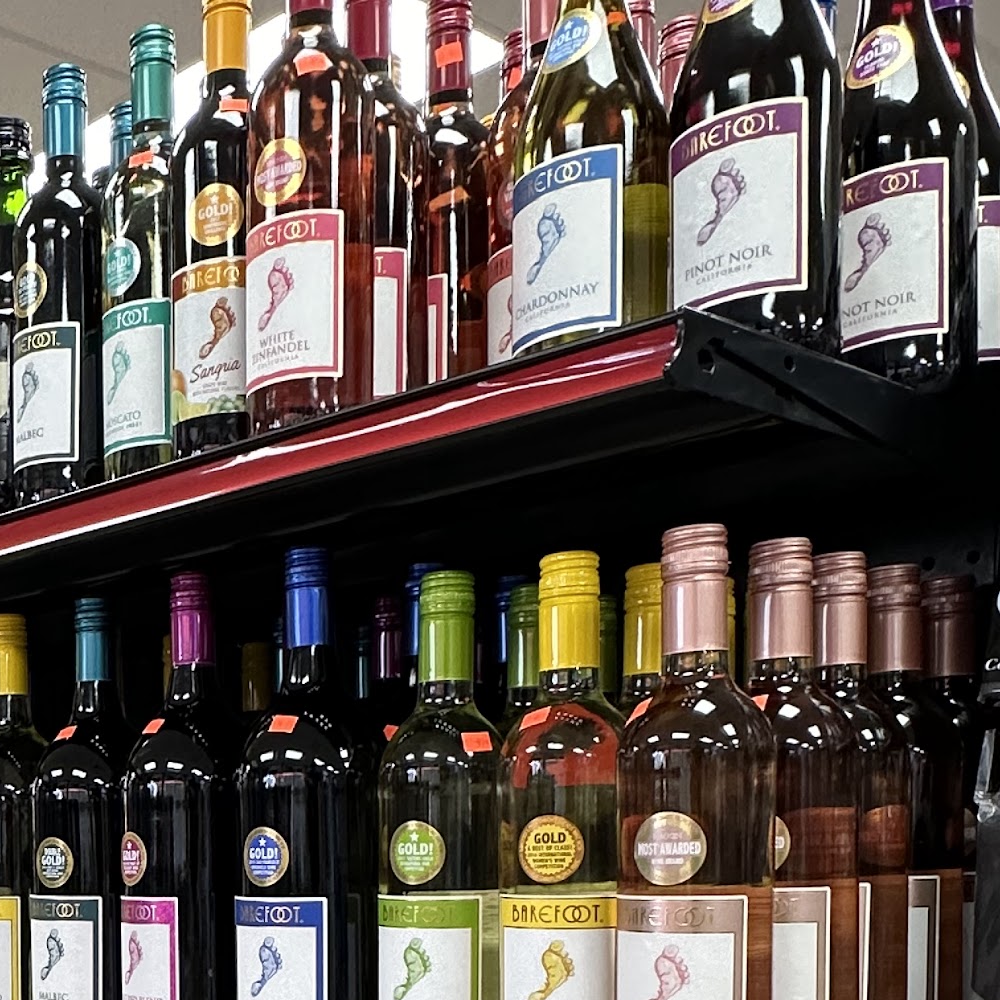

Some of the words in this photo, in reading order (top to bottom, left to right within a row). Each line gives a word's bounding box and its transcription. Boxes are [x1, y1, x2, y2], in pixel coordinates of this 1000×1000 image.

[551, 25, 589, 53] GOLD!
[855, 40, 899, 69] GOLD!
[845, 168, 919, 205] REFOOT
[198, 201, 233, 221] GOLD!
[685, 255, 726, 282] PINOT
[729, 244, 772, 267] NOIR
[515, 281, 600, 321] CHARDONNAY
[842, 301, 871, 319] NOT
[875, 291, 916, 310] NOIR
[259, 329, 295, 349] WHITE
[252, 340, 311, 366] ZINFANDEL
[189, 358, 241, 384] Sangria
[397, 842, 434, 856] GOLD!
[534, 832, 567, 844] GOLD
[637, 842, 659, 857] MOST
[659, 841, 702, 856] AWARDED
[41, 855, 66, 866] GOLD!
[249, 847, 279, 860] GOLD!
[512, 904, 602, 924] BAREFOOT
